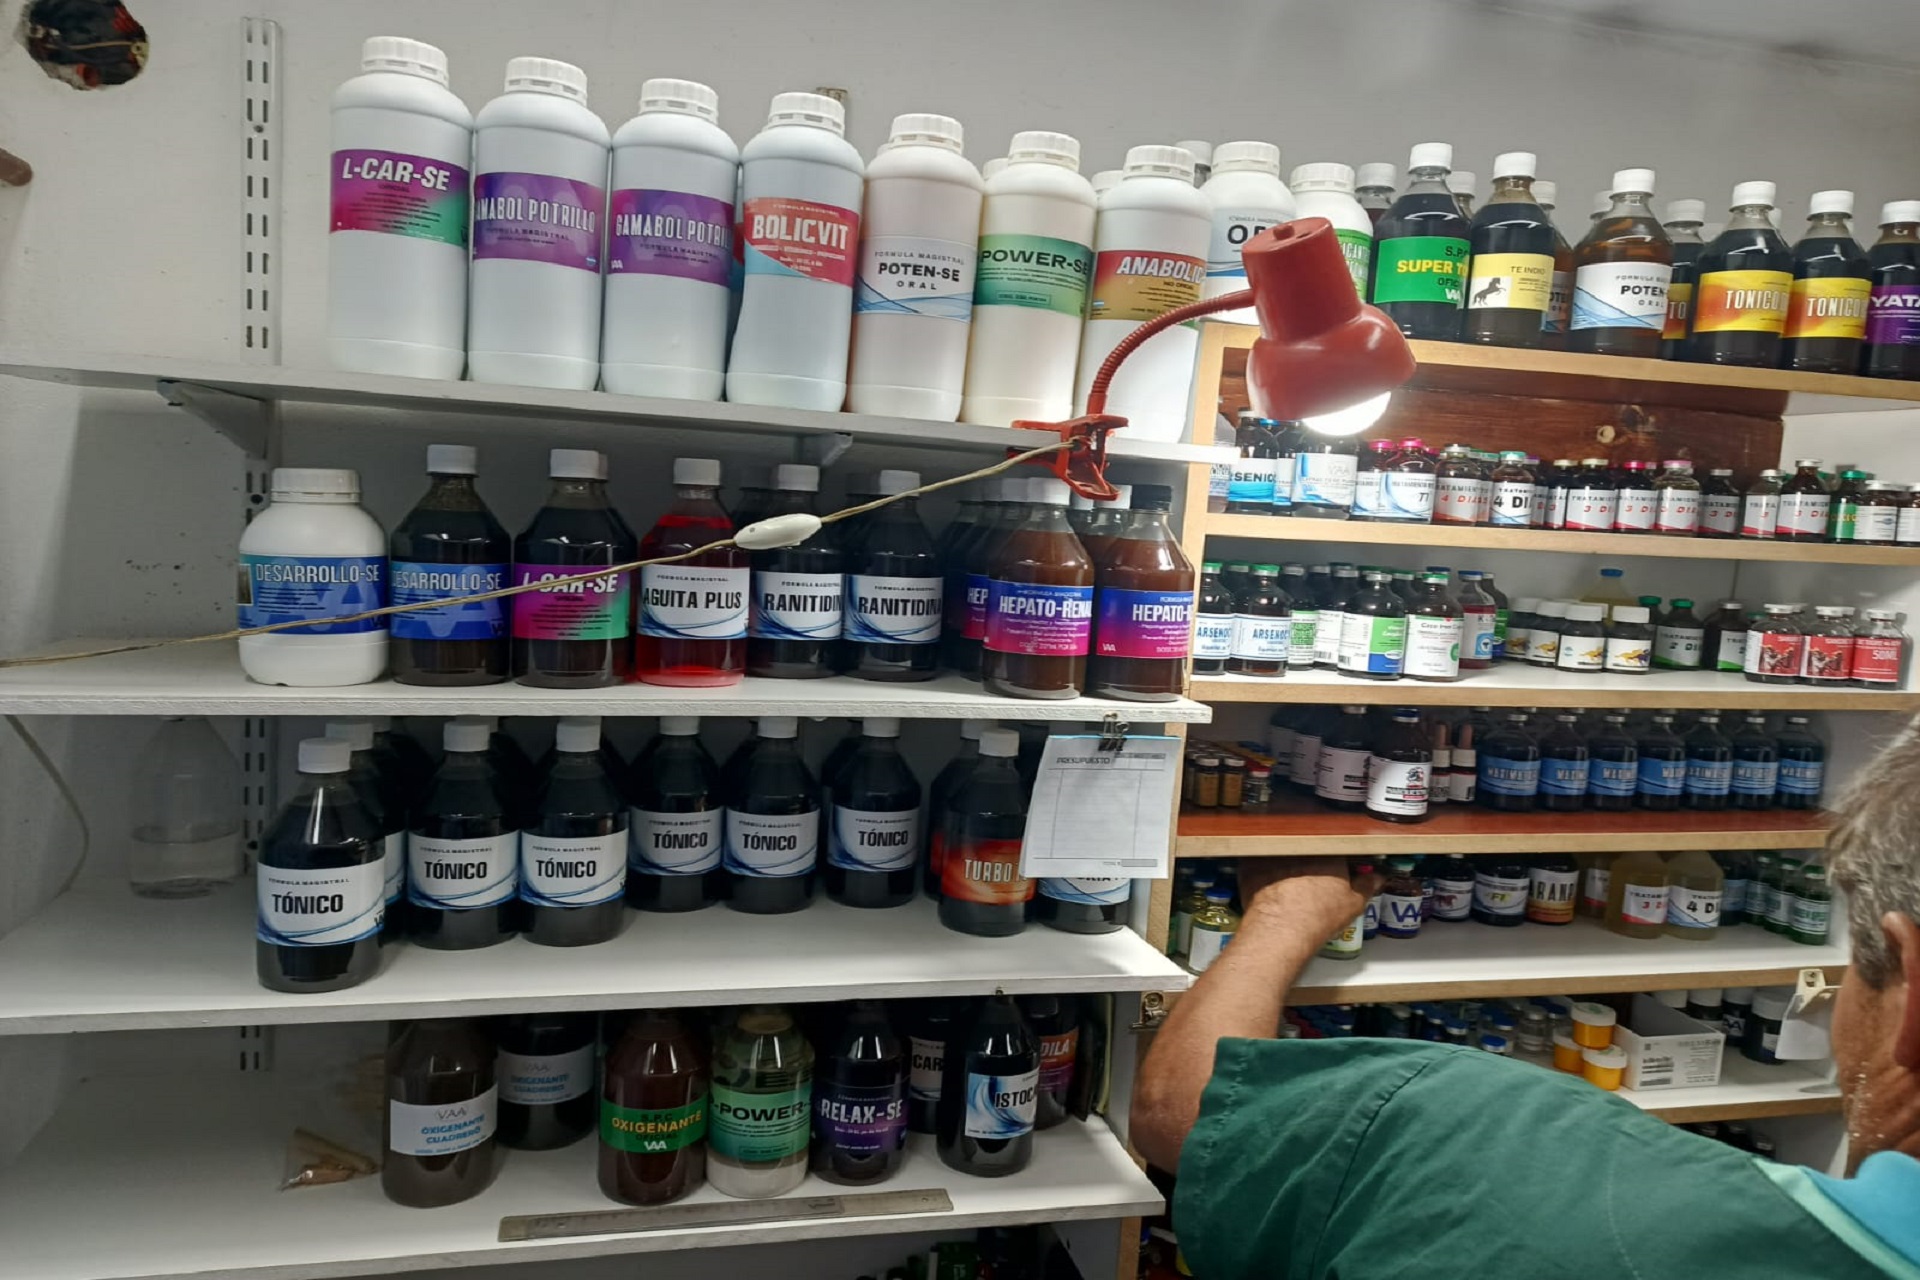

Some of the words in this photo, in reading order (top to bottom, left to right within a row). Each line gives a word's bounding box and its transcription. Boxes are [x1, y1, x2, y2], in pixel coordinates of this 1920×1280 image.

[342, 157, 450, 191] L-CAR-SE
[528, 199, 595, 232] POTRILLO
[616, 213, 683, 240] GAMABOL
[752, 214, 849, 250] BOLICVIT
[878, 262, 960, 282] POTEN-SE
[1397, 259, 1453, 274] SUPER
[1510, 266, 1522, 274] TE
[1524, 267, 1546, 275] INDIO
[896, 280, 937, 290] ORAL
[1494, 496, 1503, 507] 4
[1583, 505, 1592, 513] 3
[256, 563, 380, 583] DESARROLLO-SE
[643, 588, 698, 609] AGUITA
[704, 591, 742, 609] PLUS
[1056, 757, 1110, 765] PRESUPUESTO
[653, 830, 708, 849] TÓNICO
[743, 831, 797, 851] TÓNICO
[858, 828, 909, 847] TÓNICO
[424, 860, 488, 880] TÓNICO
[536, 858, 597, 878] TÓNICO
[964, 859, 1013, 882] TURBO
[271, 891, 344, 915] TÓNICO
[1641, 902, 1651, 910] 3
[1686, 901, 1698, 914] 4
[821, 1098, 904, 1124] RELAX-SE
[612, 1110, 702, 1134] OXIGENANTE
[426, 1126, 481, 1144] CUADRERO
